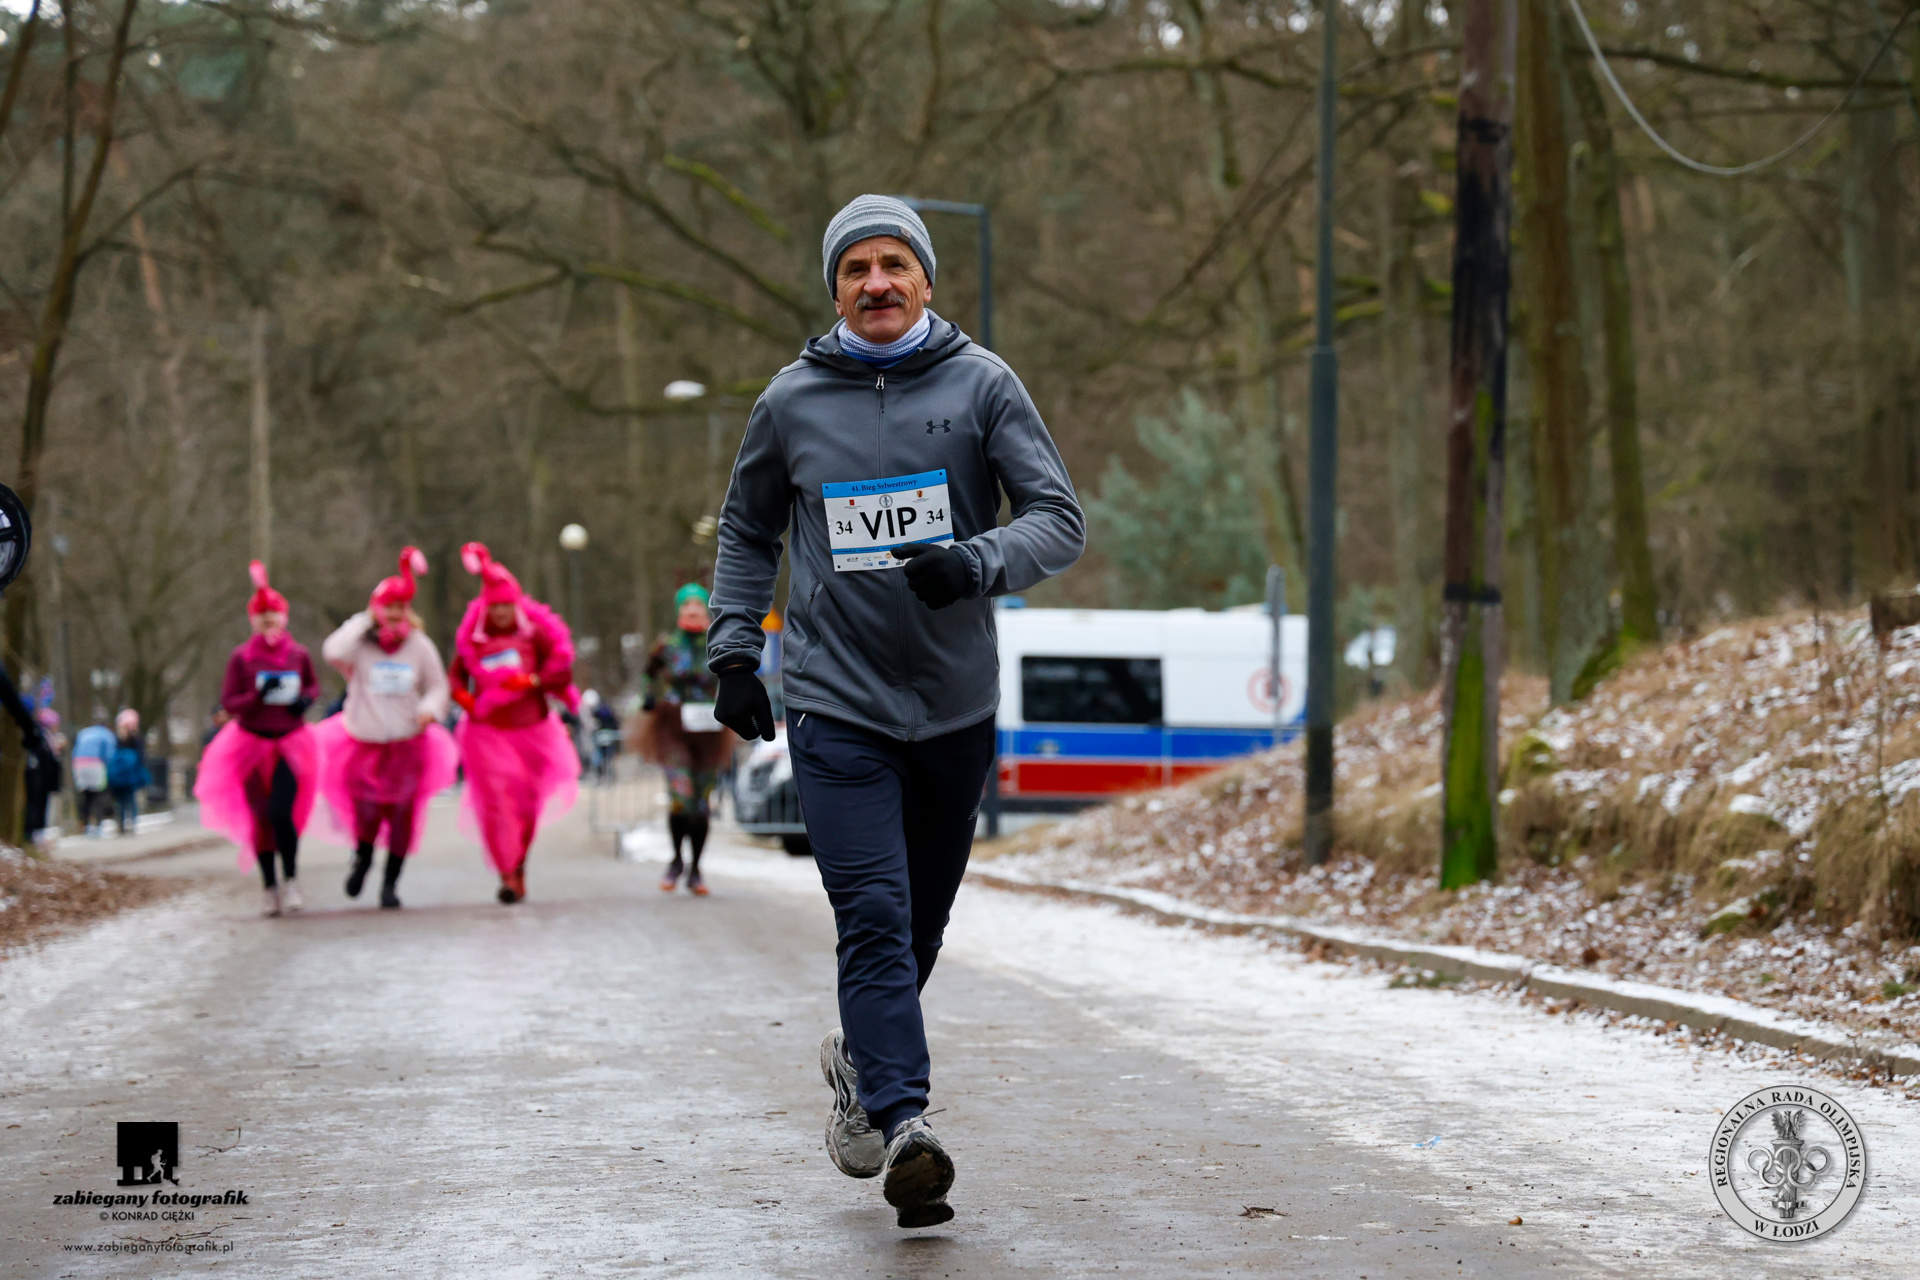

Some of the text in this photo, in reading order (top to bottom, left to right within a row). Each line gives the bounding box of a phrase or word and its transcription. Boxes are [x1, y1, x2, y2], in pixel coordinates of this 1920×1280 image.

[835, 507, 944, 540] 34 VIP 34
